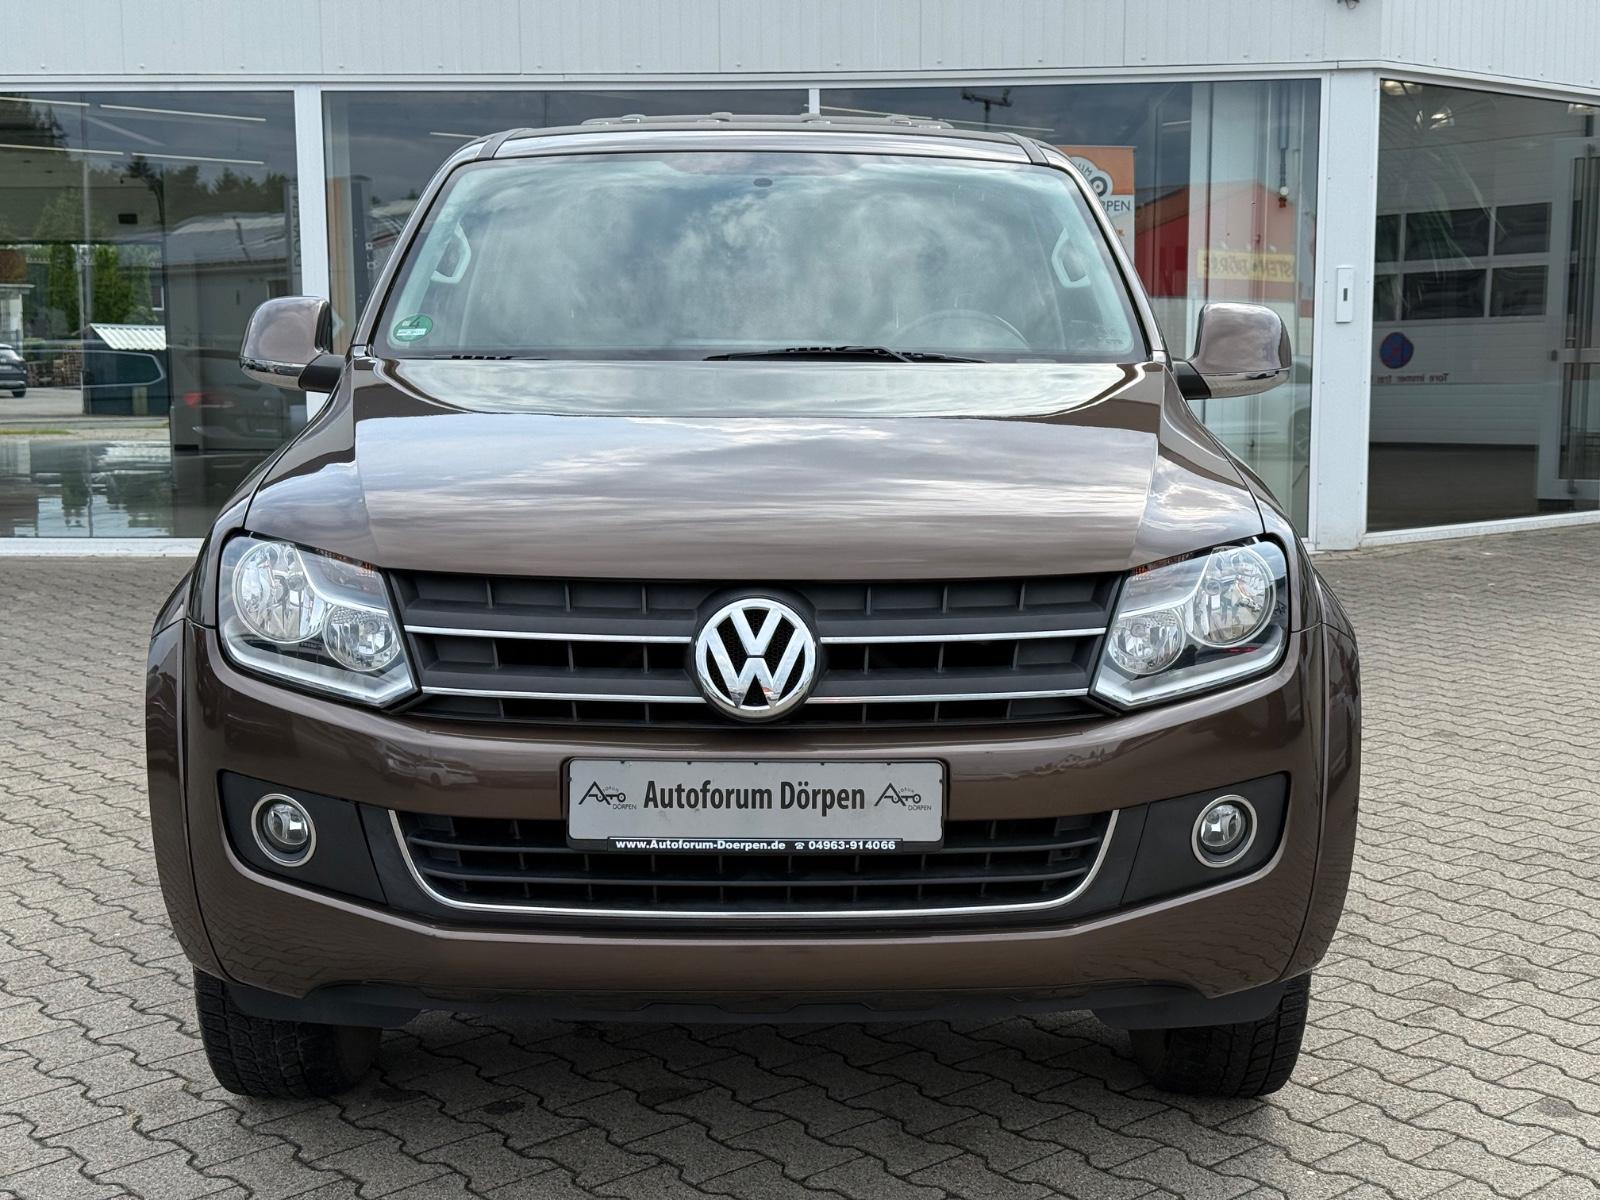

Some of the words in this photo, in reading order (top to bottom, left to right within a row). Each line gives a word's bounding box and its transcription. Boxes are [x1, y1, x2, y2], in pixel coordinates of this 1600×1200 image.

[643, 780, 773, 810] Autoforum
[780, 780, 865, 817] Dörpen
[615, 839, 786, 851] www.Autoforum-Doerpen.de
[808, 840, 896, 850] 04963-914066
